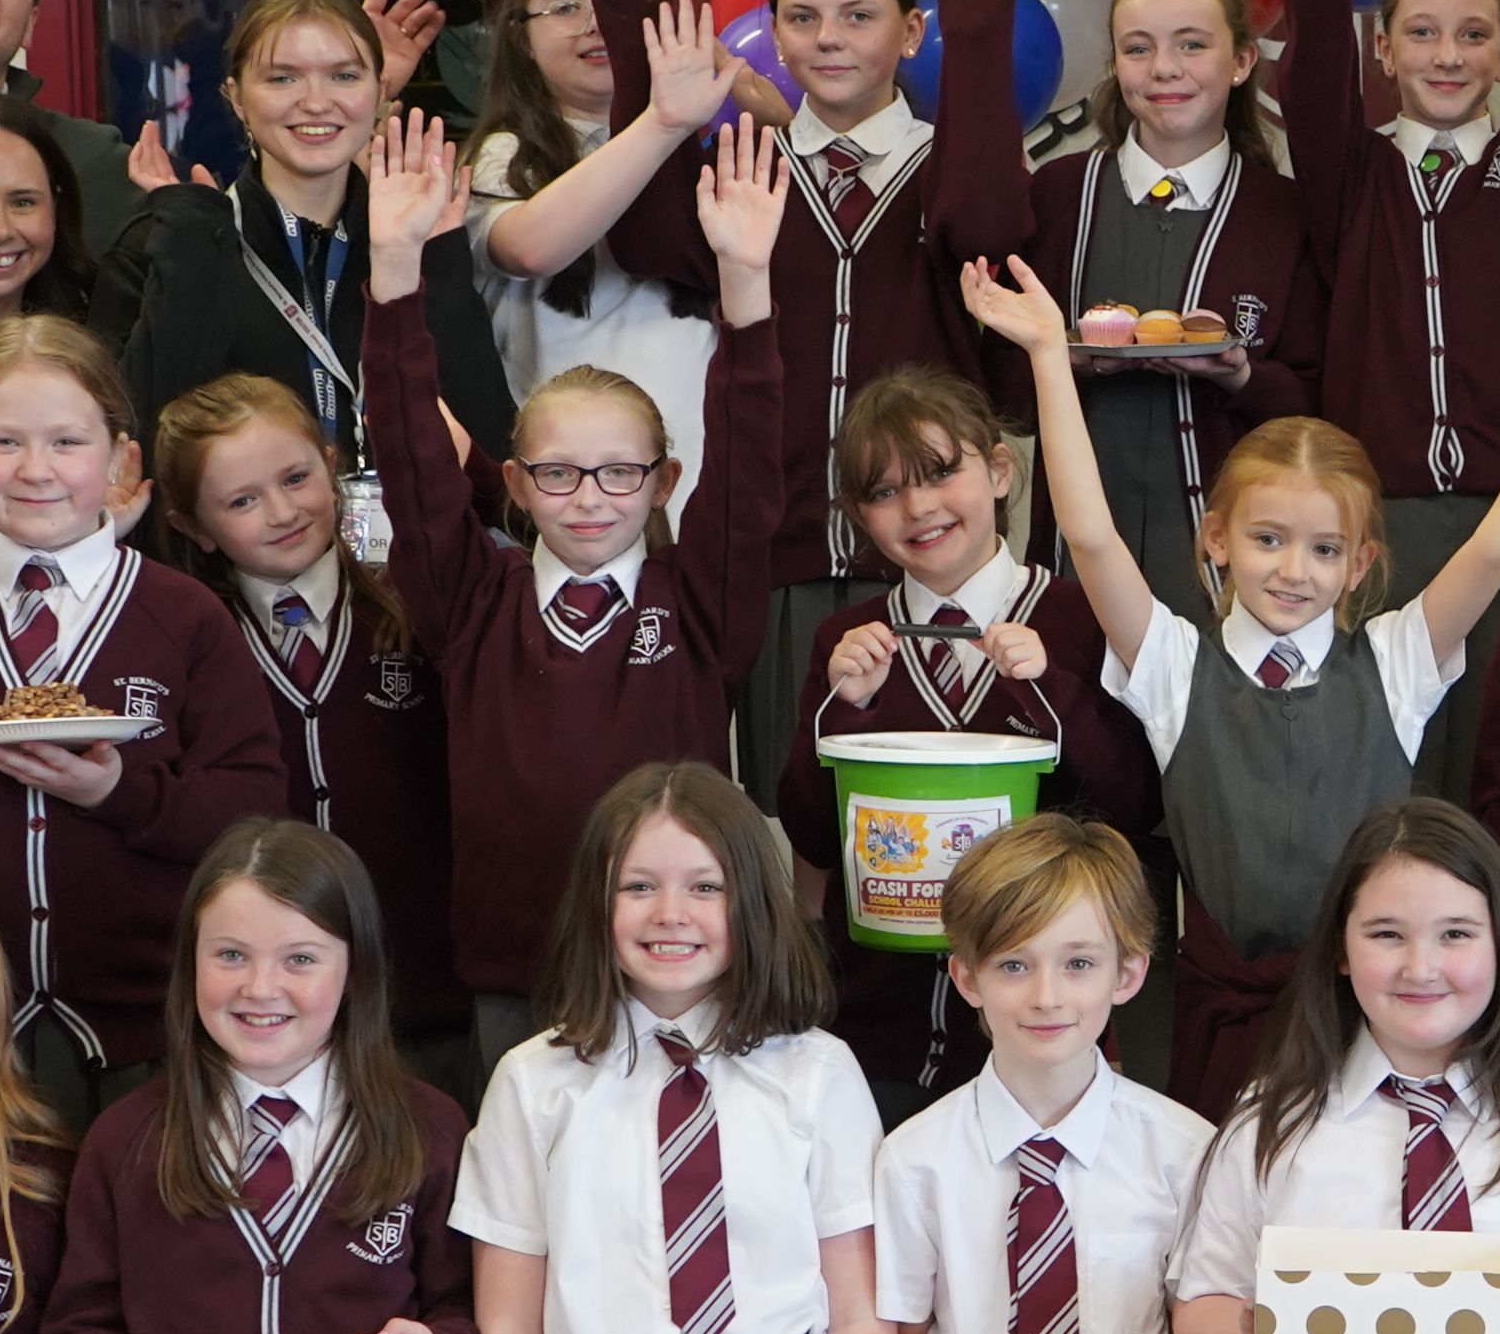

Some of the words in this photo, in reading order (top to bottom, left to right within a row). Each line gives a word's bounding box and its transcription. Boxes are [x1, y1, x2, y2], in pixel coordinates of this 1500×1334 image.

[867, 879, 908, 897] CASH
[911, 882, 945, 899] FOR
[868, 895, 903, 907] SCHOOL
[345, 1241, 385, 1266] PRIMARY
